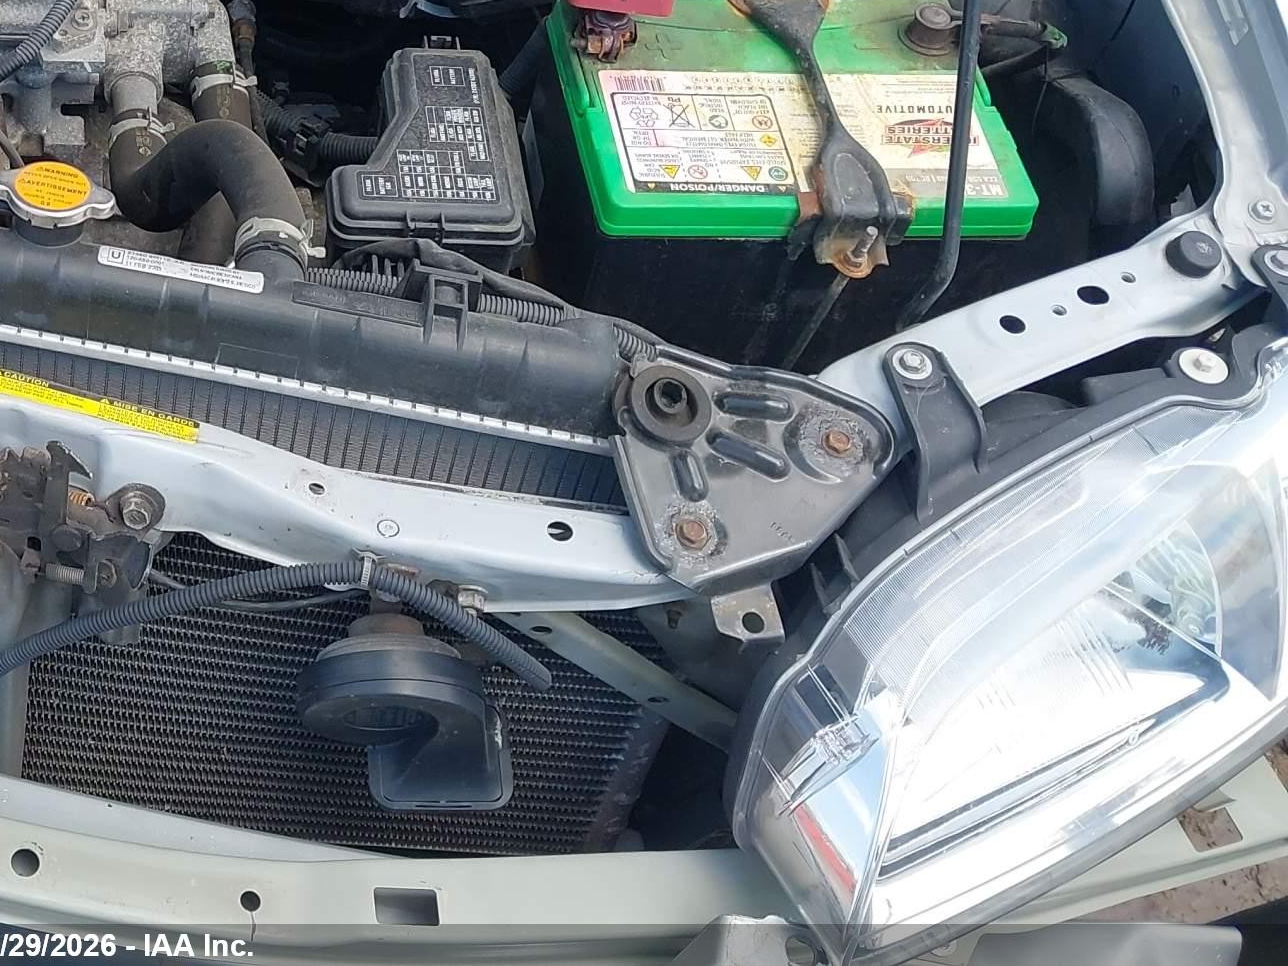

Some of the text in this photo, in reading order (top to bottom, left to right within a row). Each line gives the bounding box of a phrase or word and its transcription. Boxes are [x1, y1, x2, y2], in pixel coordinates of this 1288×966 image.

[876, 105, 953, 114] UTOMOTIVE
[888, 126, 952, 134] TTERIES
[884, 136, 977, 145] IERSTATE
[45, 167, 79, 179] WARNING
[26, 179, 87, 196] AVERTISSEMENT
[670, 184, 765, 193] DANGER/POISON
[3, 370, 50, 389] CAUTION
[113, 400, 196, 428] MISE EN GARDE
